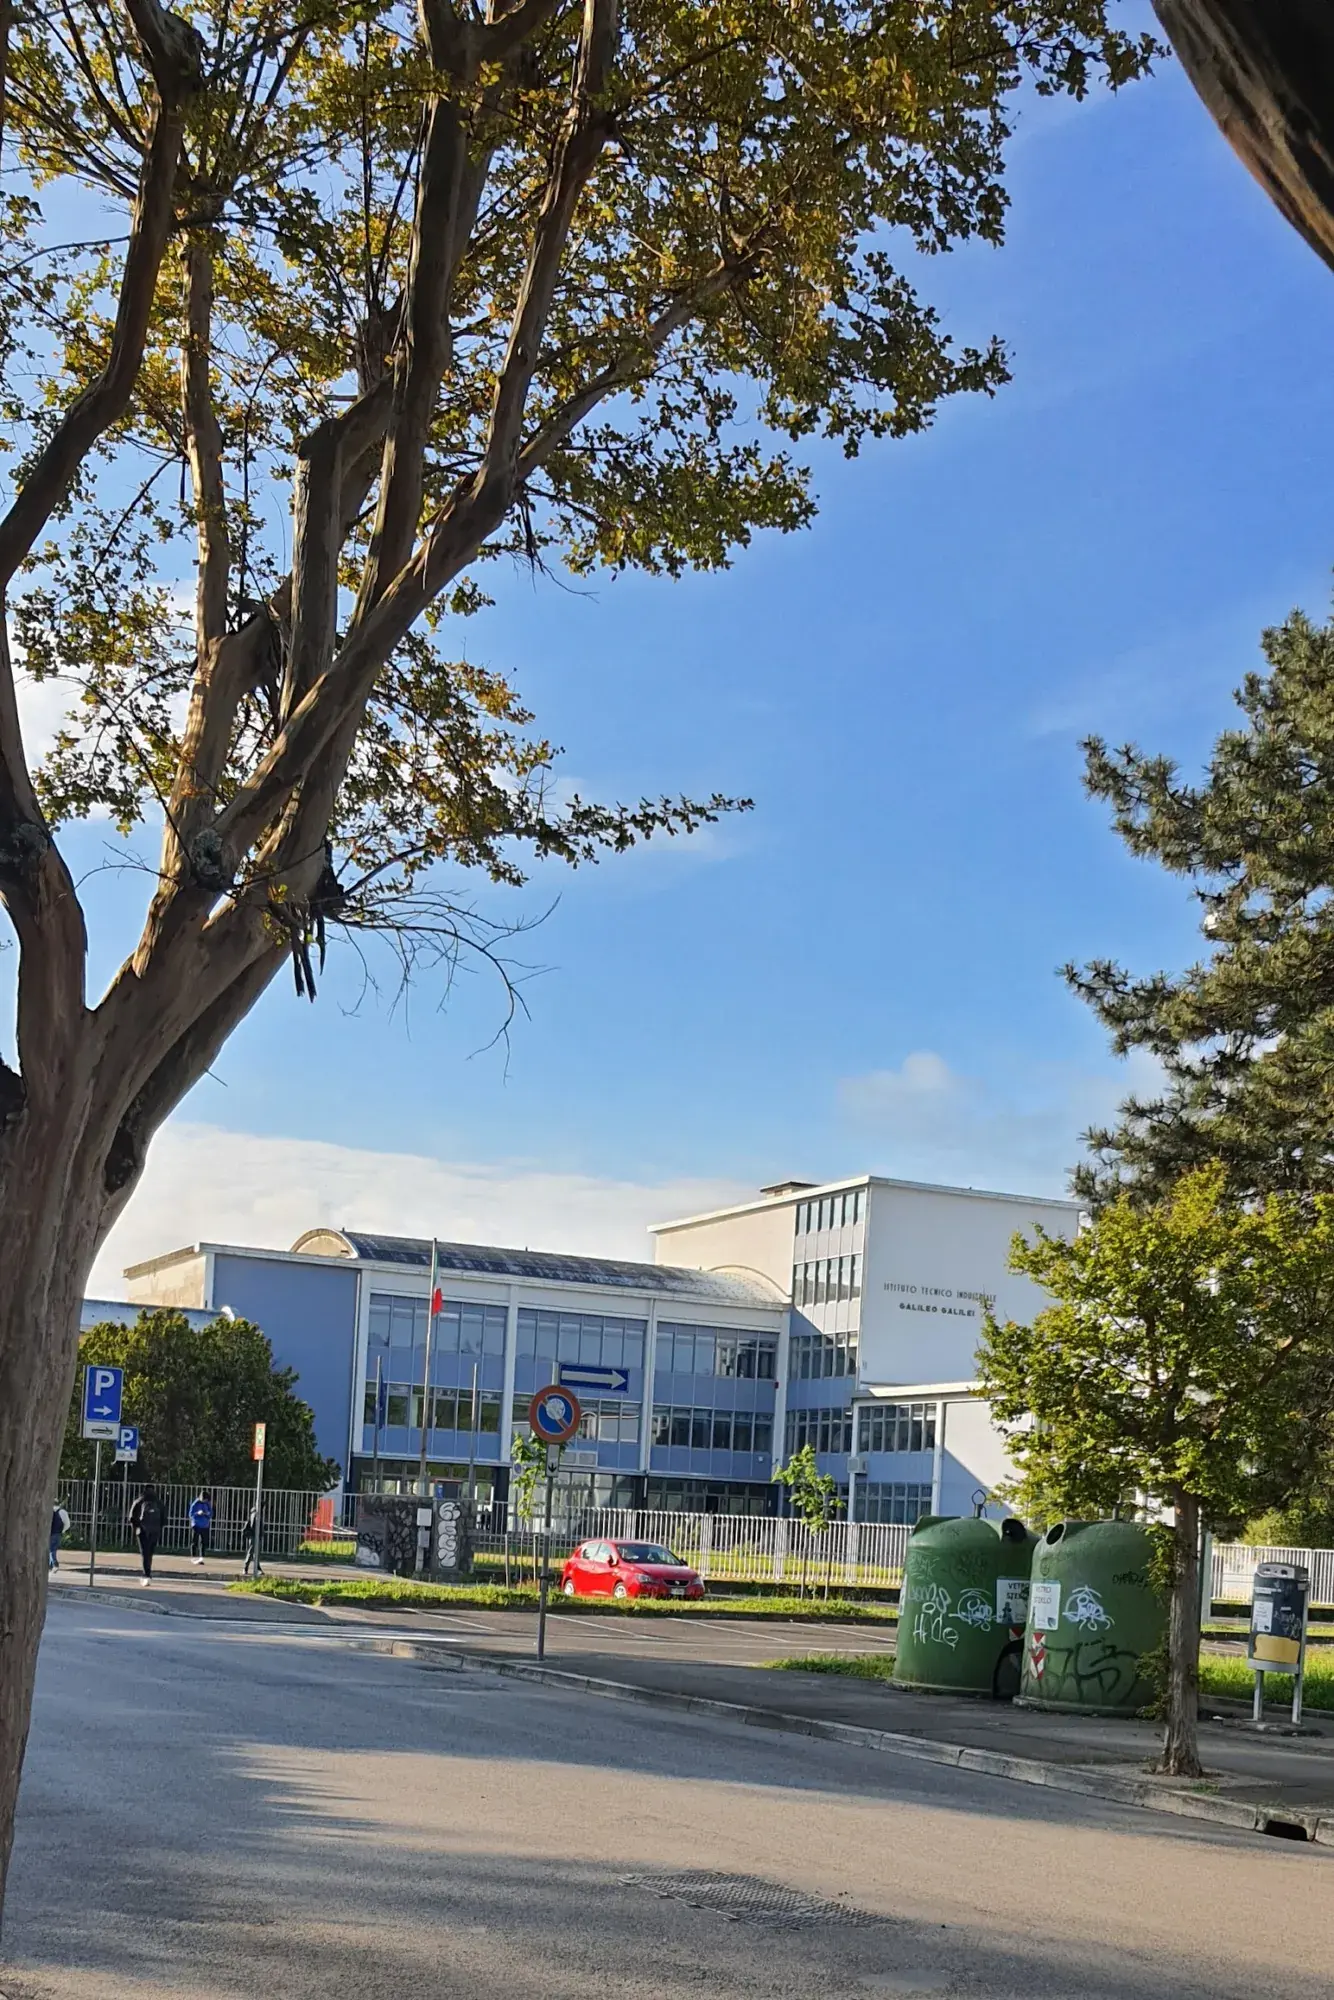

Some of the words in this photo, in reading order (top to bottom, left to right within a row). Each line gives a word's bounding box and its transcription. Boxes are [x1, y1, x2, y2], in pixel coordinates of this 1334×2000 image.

[883, 1282, 917, 1294] ISTITUTO
[921, 1286, 953, 1298] TECNICO
[899, 1302, 938, 1313] GALILEO
[941, 1307, 976, 1317] GALILEI
[94, 1370, 115, 1396] P
[120, 1429, 134, 1448] P
